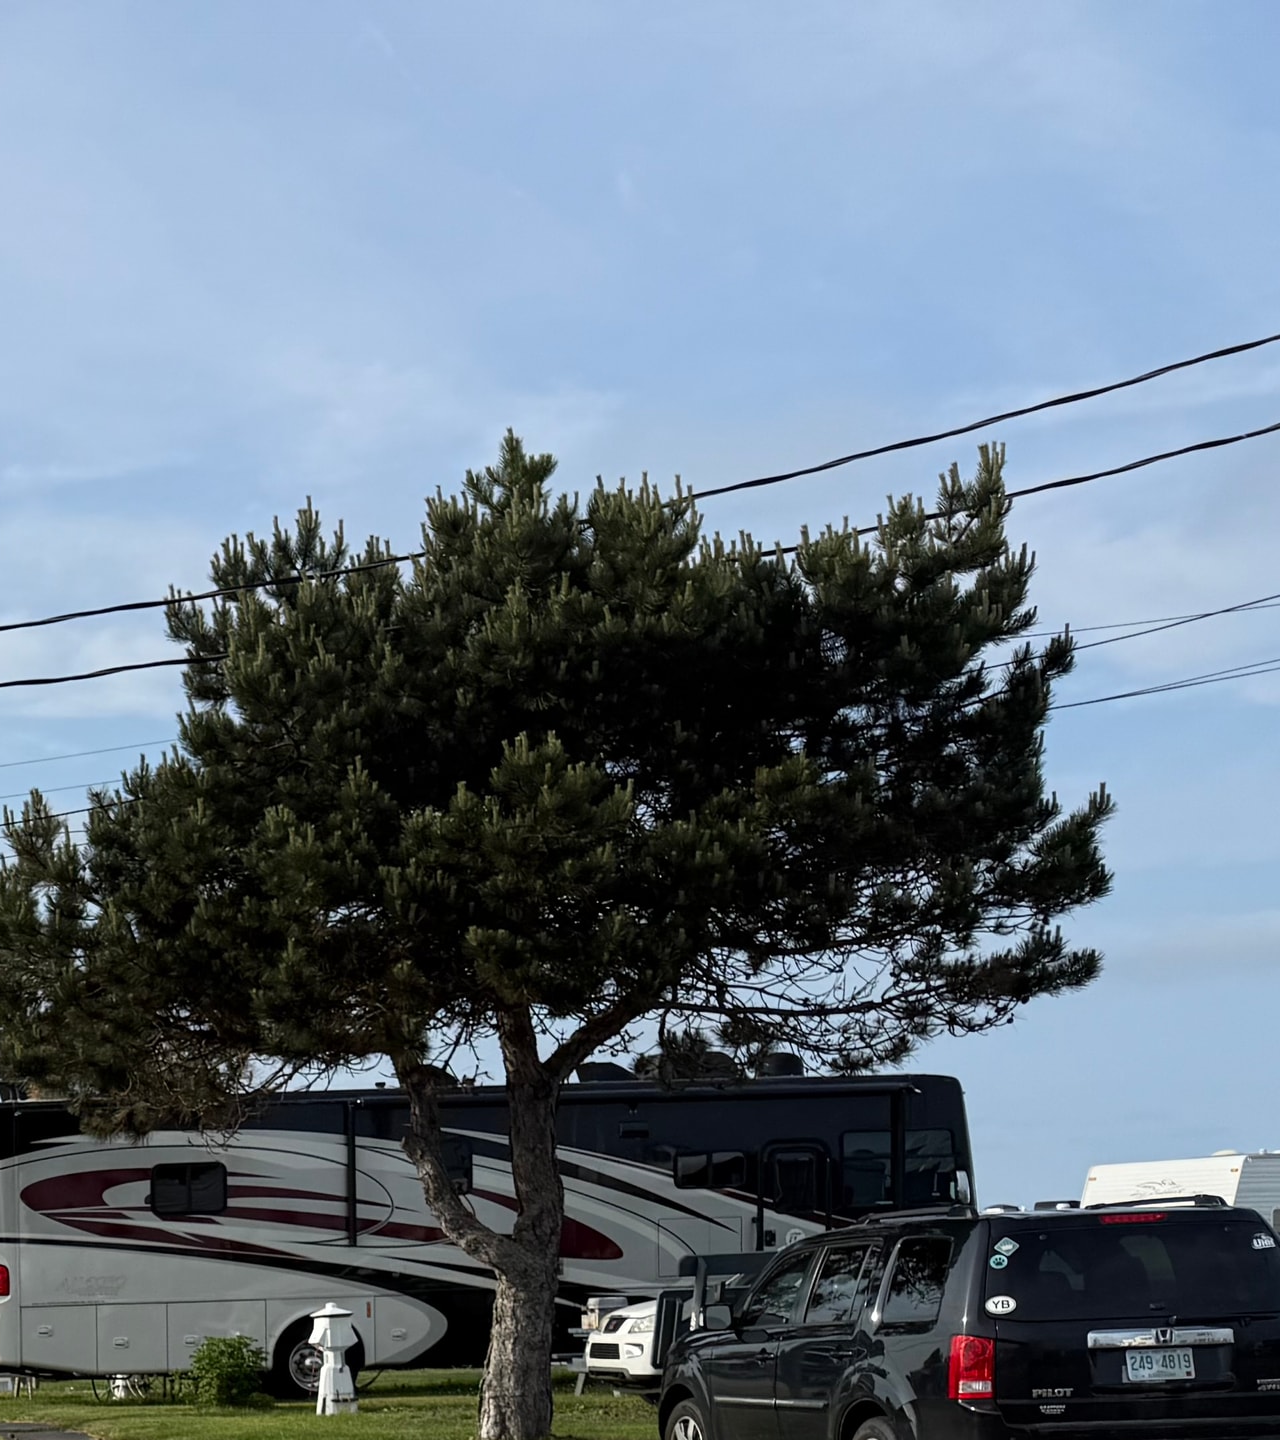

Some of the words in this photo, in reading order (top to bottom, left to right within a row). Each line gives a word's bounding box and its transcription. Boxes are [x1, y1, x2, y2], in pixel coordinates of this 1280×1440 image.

[992, 1299, 1010, 1309] YB
[1130, 1355, 1153, 1371] 249
[1161, 1353, 1191, 1370] 4819
[1032, 1388, 1074, 1398] PILOT
